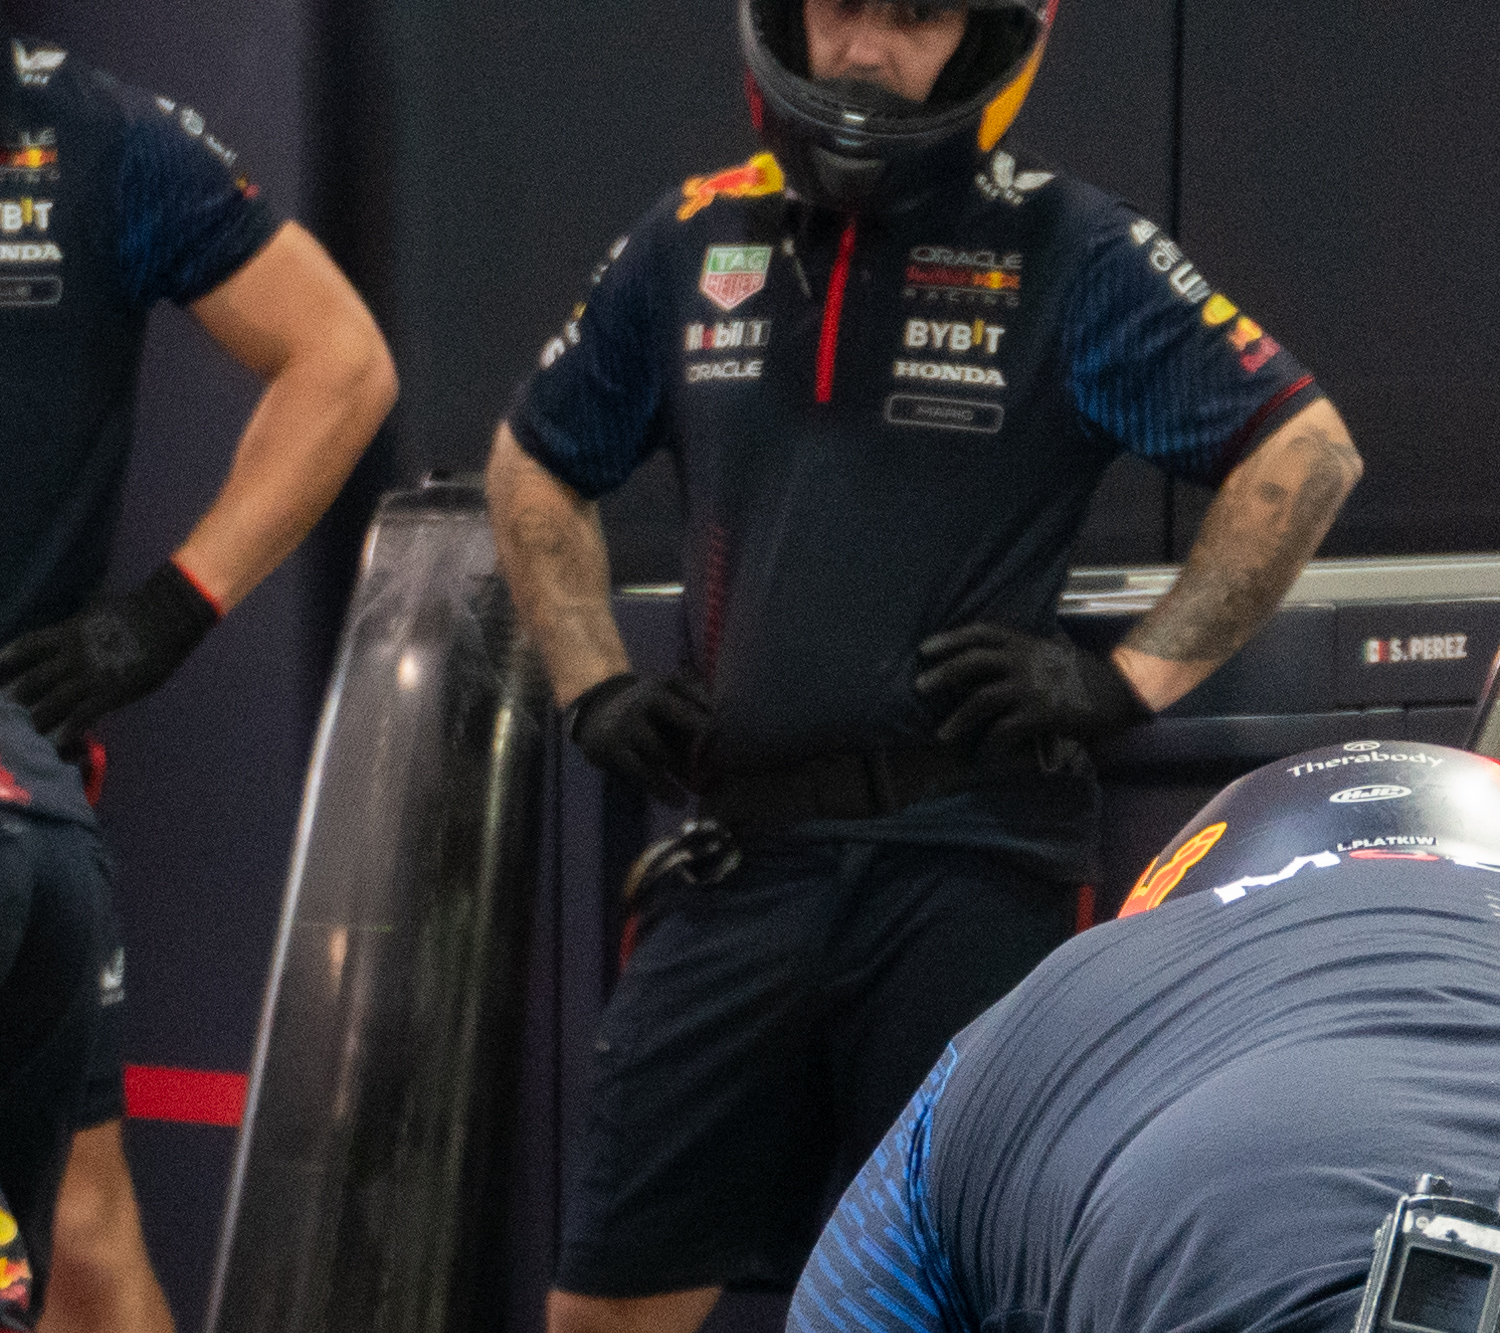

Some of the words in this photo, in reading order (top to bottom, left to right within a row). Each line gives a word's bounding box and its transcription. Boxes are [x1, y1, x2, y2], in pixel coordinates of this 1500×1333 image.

[910, 245, 1023, 270] ORACLE
[905, 318, 1006, 354] BYBIT
[685, 359, 765, 384] ORACLE
[893, 359, 1007, 387] HONDA
[1286, 751, 1444, 778] Therabody
